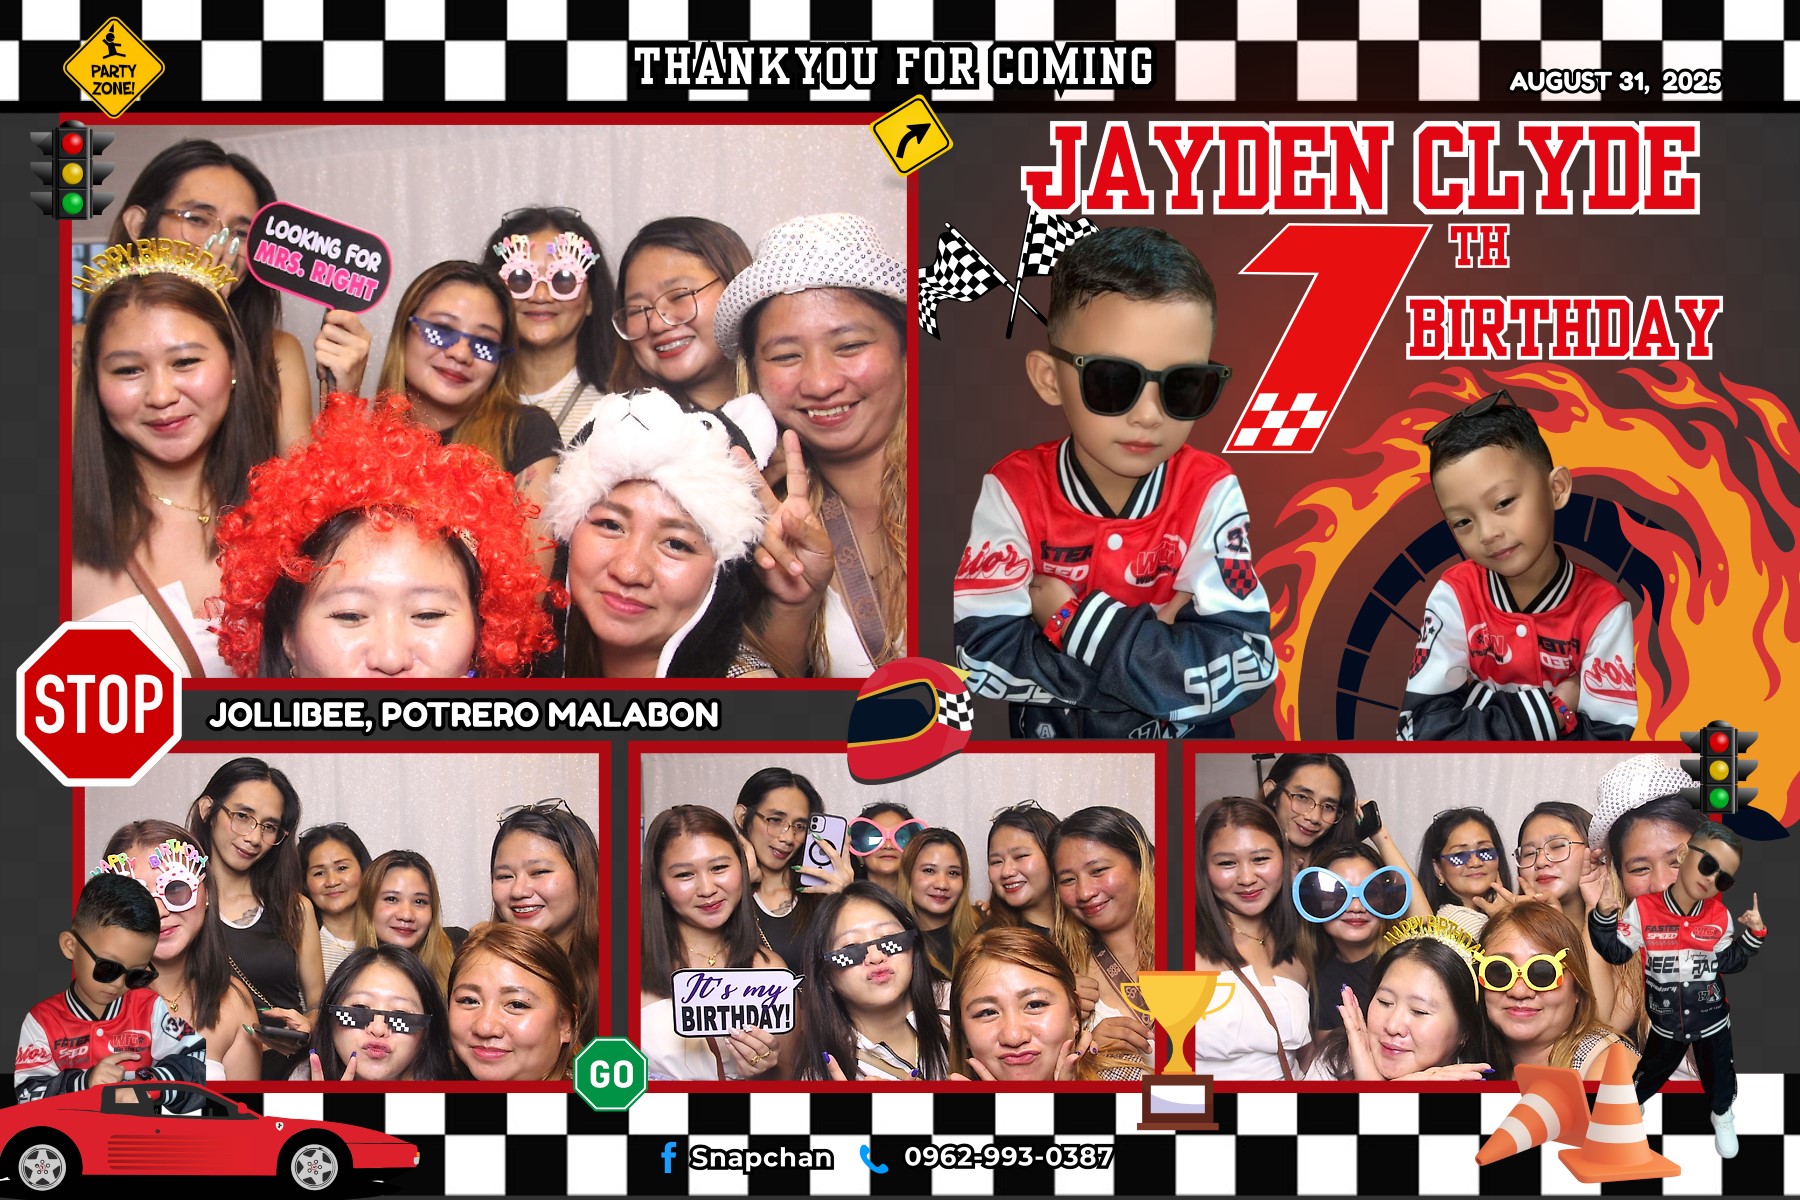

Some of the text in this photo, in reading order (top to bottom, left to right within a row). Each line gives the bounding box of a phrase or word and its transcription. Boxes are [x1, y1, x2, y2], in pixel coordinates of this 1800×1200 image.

[91, 64, 137, 78] PARTY
[91, 81, 135, 95] ZONE!
[265, 215, 382, 273] LOOKING FOR
[71, 237, 239, 295] HAPPY BIRTHDAY
[253, 239, 380, 302] MRS. RIGHT
[35, 674, 163, 734] STOP
[148, 838, 209, 869] BIRTHDAY
[681, 973, 788, 1009] It's my
[681, 1003, 791, 1032] BIRTHDAY!
[590, 1060, 634, 1089] GO
